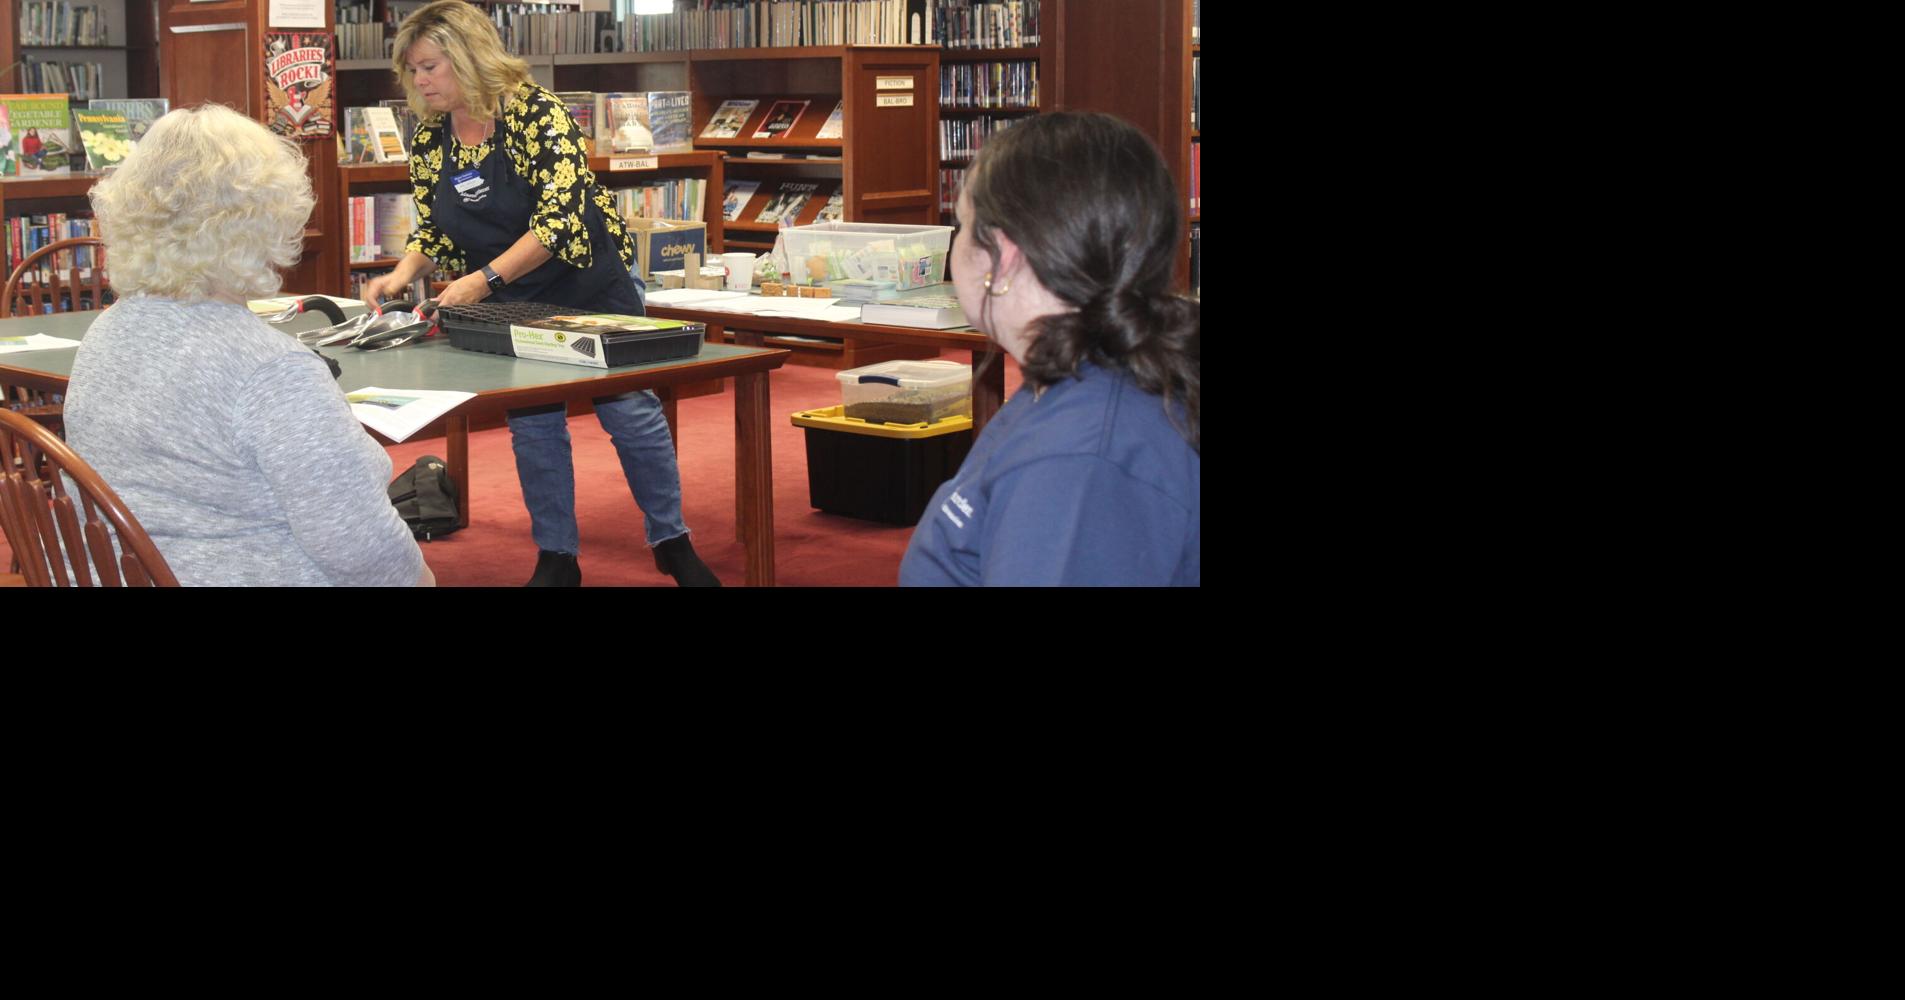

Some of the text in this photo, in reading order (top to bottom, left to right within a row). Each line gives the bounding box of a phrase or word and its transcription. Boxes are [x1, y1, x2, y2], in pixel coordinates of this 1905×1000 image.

[271, 49, 323, 74] LIBRARIES
[618, 160, 649, 169] ATW-BAL
[661, 243, 695, 256] chewy
[514, 329, 544, 341] Pro-Hex
